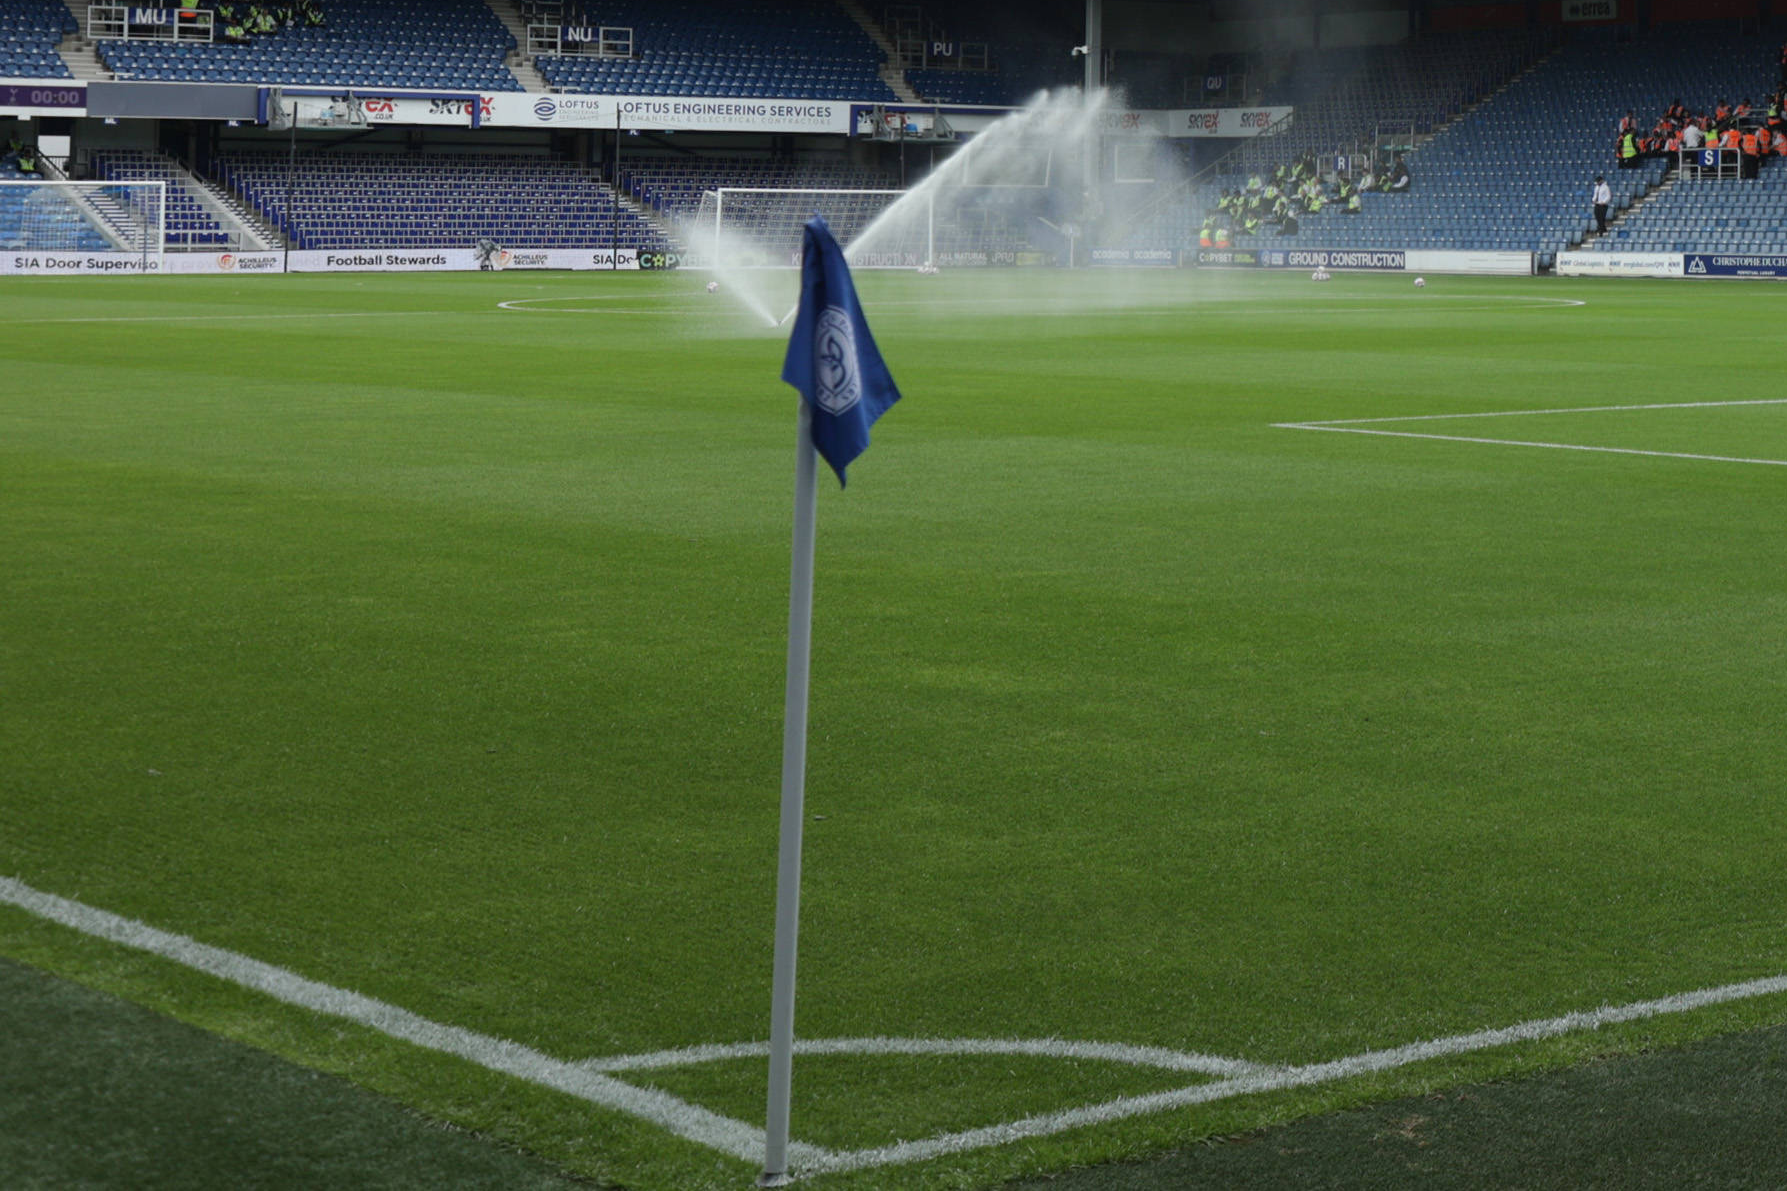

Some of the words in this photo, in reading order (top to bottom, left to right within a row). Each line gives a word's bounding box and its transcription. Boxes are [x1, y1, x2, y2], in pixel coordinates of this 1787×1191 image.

[135, 8, 167, 25] MU
[568, 26, 592, 42] NU
[933, 42, 953, 57] PU
[31, 89, 80, 105] 00:00
[559, 100, 599, 109] LOFTUS
[617, 101, 670, 114] LOFTUS
[673, 103, 767, 116] ENGINEERING
[769, 105, 832, 118] SERVICES
[1338, 156, 1346, 170] R
[1704, 150, 1714, 166] S
[14, 257, 40, 269] SIA
[45, 257, 82, 269] Door
[327, 255, 382, 266] Football
[386, 254, 447, 266] Stewards
[593, 254, 614, 265] SIA
[1288, 251, 1328, 266] GROUND
[1330, 252, 1404, 267] CONSTRUCTION
[1712, 256, 1760, 267] CHRISTOPHE
